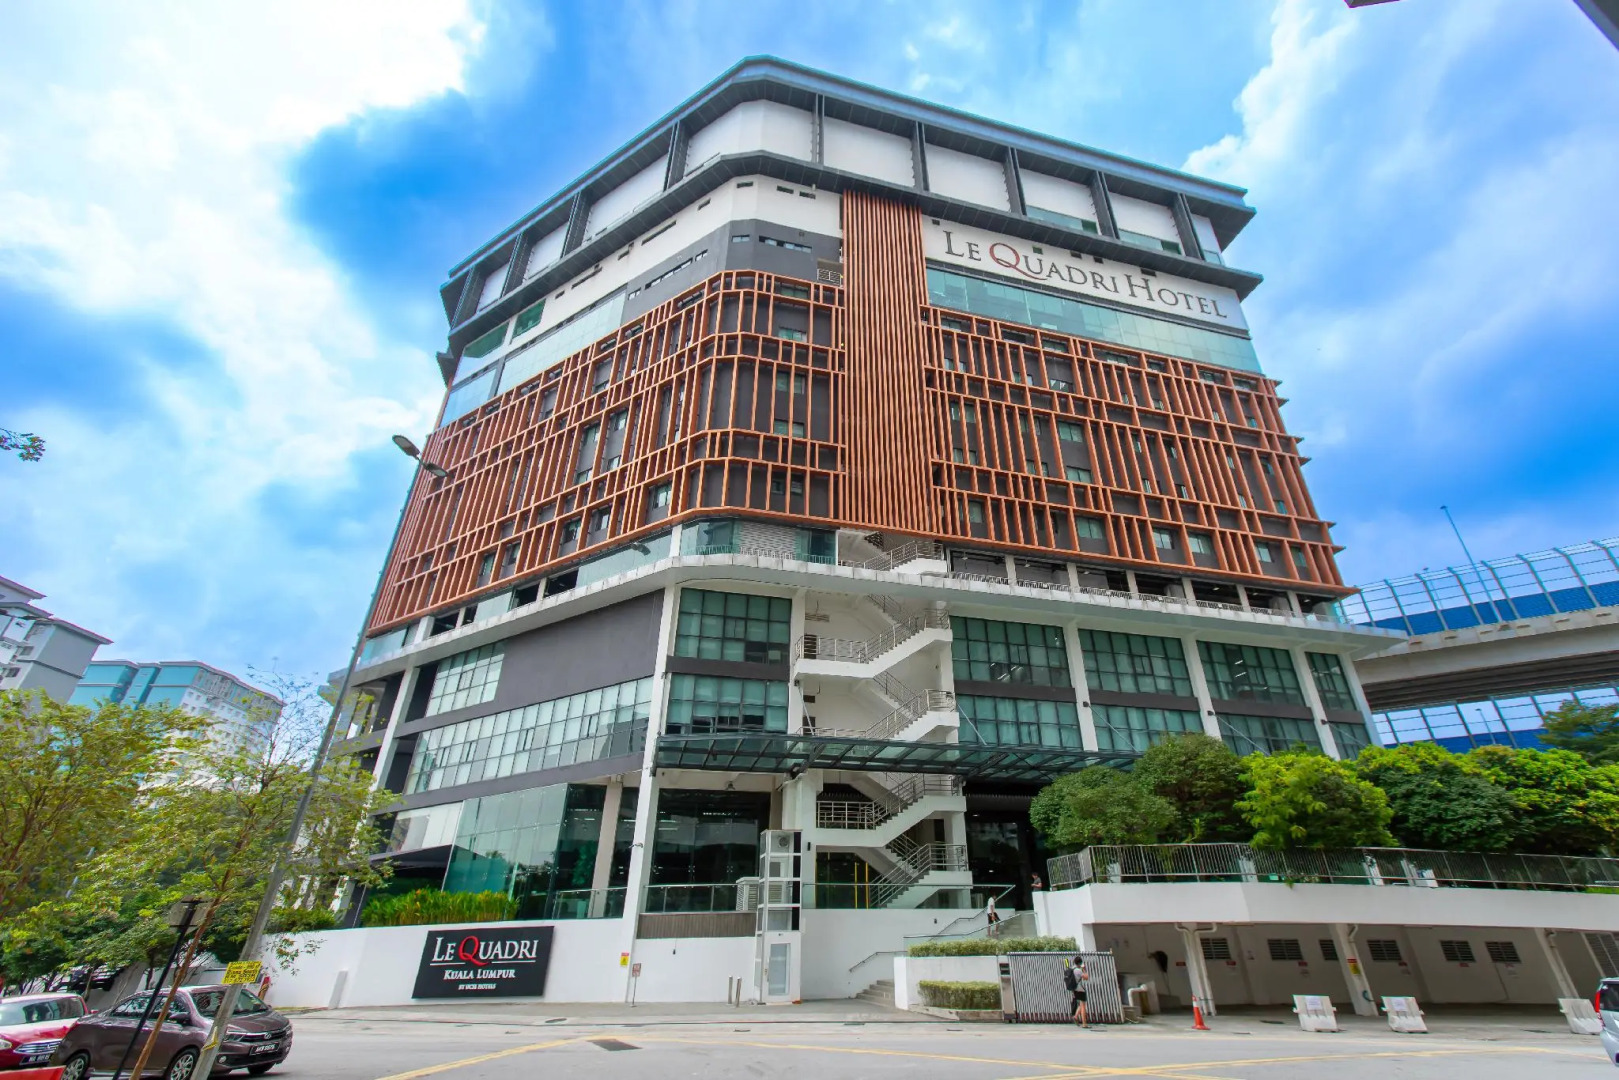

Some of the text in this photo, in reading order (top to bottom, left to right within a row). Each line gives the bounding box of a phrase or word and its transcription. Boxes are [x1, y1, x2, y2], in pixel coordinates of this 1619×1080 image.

[943, 231, 1227, 319] LE QUADRI HOTEL
[432, 936, 538, 966] LE QUADRI
[443, 969, 516, 980] KUALA LUMPUR
